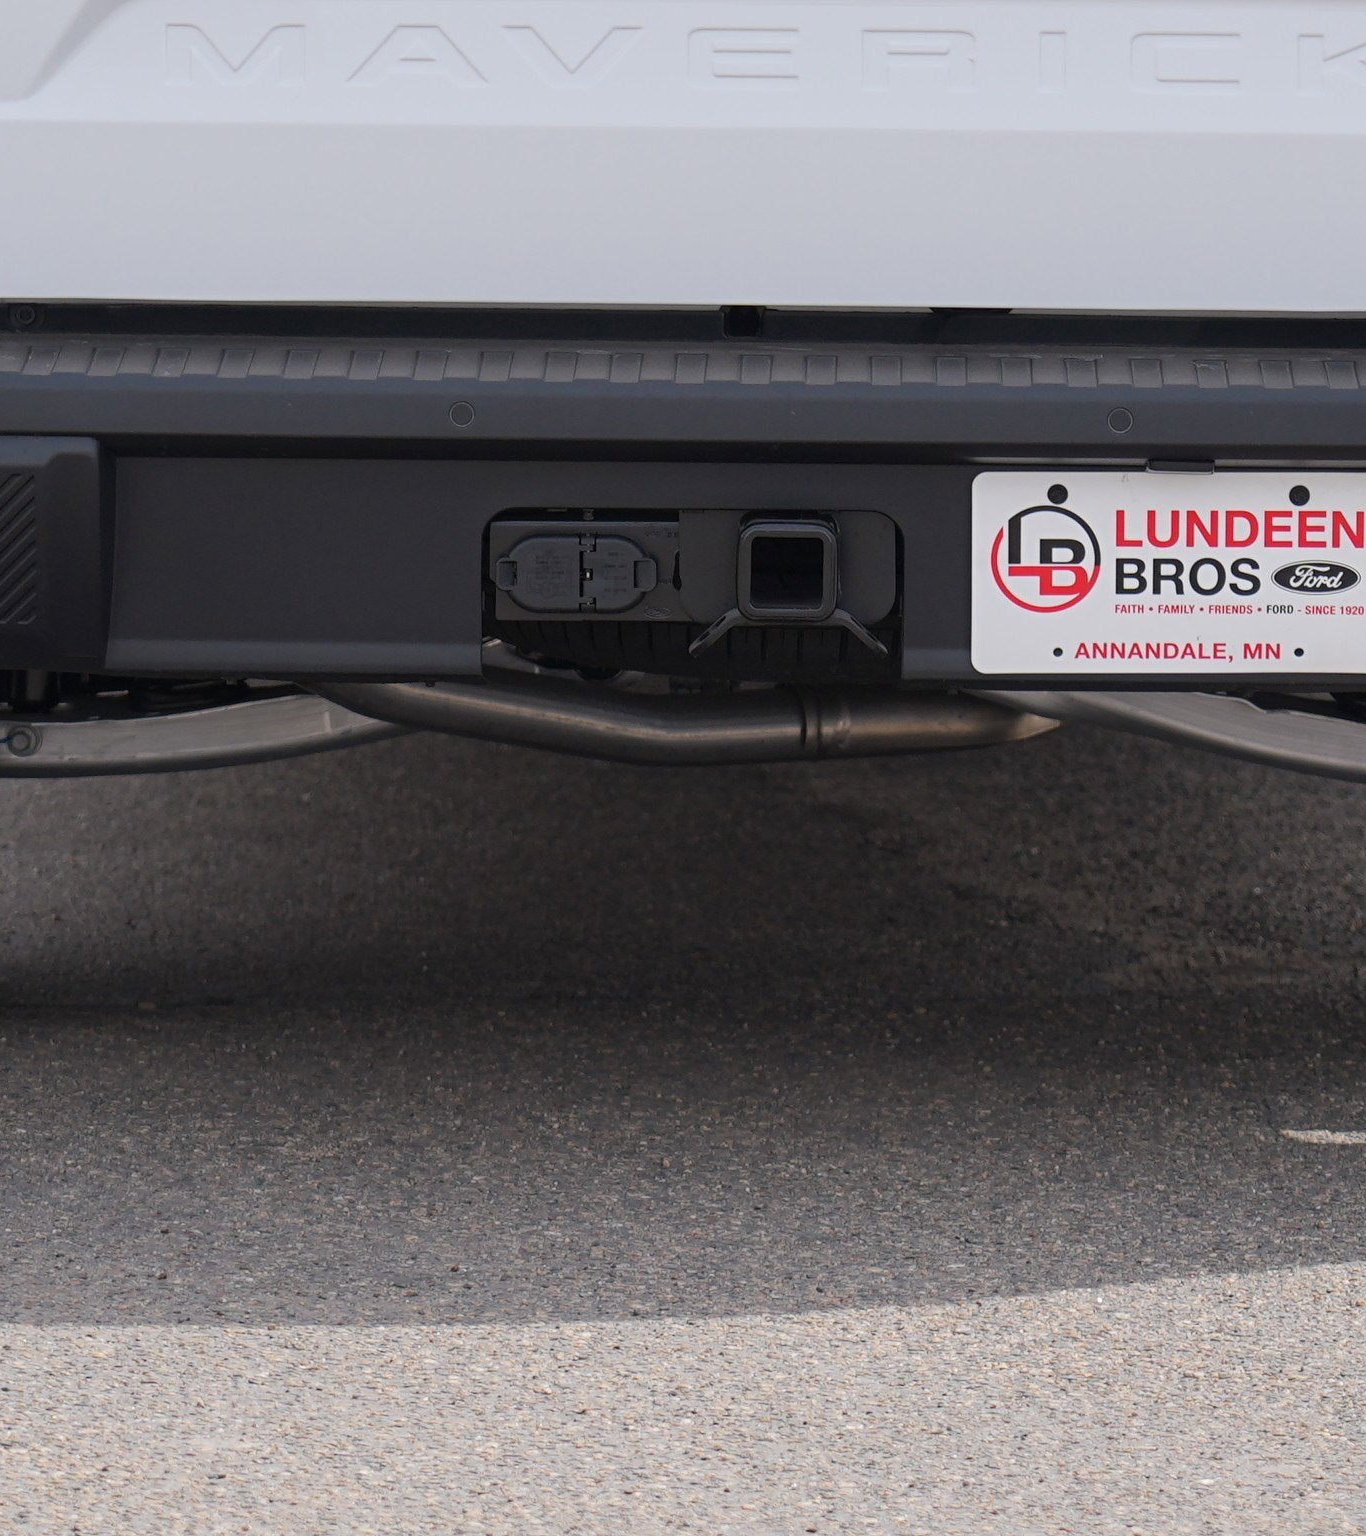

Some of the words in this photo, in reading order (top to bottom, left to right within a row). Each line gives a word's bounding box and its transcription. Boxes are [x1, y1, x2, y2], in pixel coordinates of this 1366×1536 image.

[1115, 509, 1365, 549] LUNDEEN
[1115, 557, 1261, 596] BROS
[1289, 565, 1344, 588] Ford
[1114, 604, 1144, 614] FAITH
[1157, 604, 1195, 614] FAMILY
[1208, 604, 1253, 615] FRIENDS
[1266, 604, 1294, 615] FORD
[1305, 605, 1336, 615] SINCE
[1340, 605, 1365, 616] 1920
[1074, 642, 1234, 663] ANNANDALE,
[1243, 642, 1281, 660] MN
